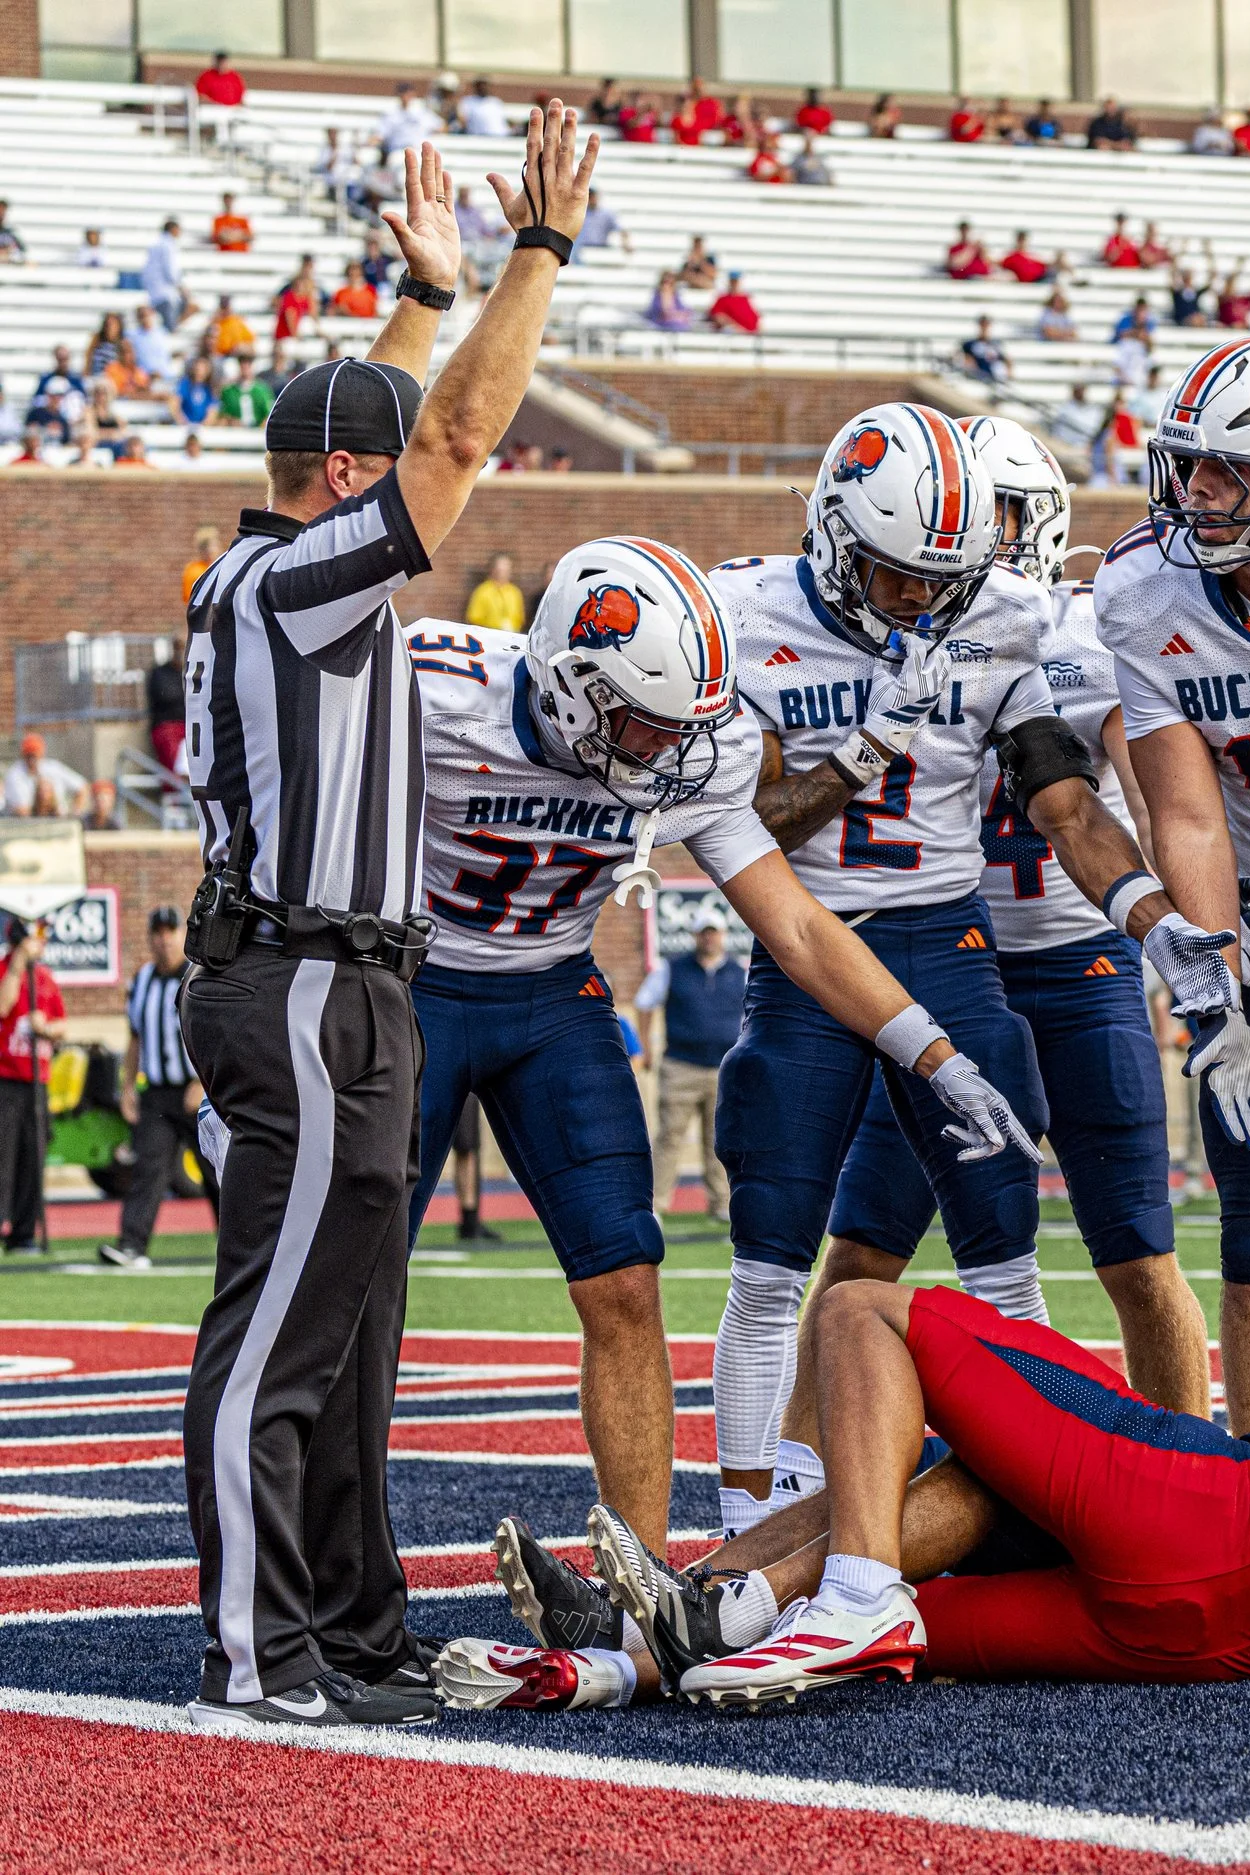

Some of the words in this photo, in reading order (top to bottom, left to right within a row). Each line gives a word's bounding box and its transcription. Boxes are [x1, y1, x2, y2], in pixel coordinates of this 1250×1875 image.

[1161, 425, 1195, 442] BUCKNELL
[919, 550, 963, 564] BUCKNELL
[408, 633, 489, 688] 37
[693, 695, 728, 716] Riddell
[860, 739, 882, 764] adidas
[465, 796, 636, 846] BUCKNEL
[839, 752, 923, 871] 2
[427, 829, 627, 935] 37
